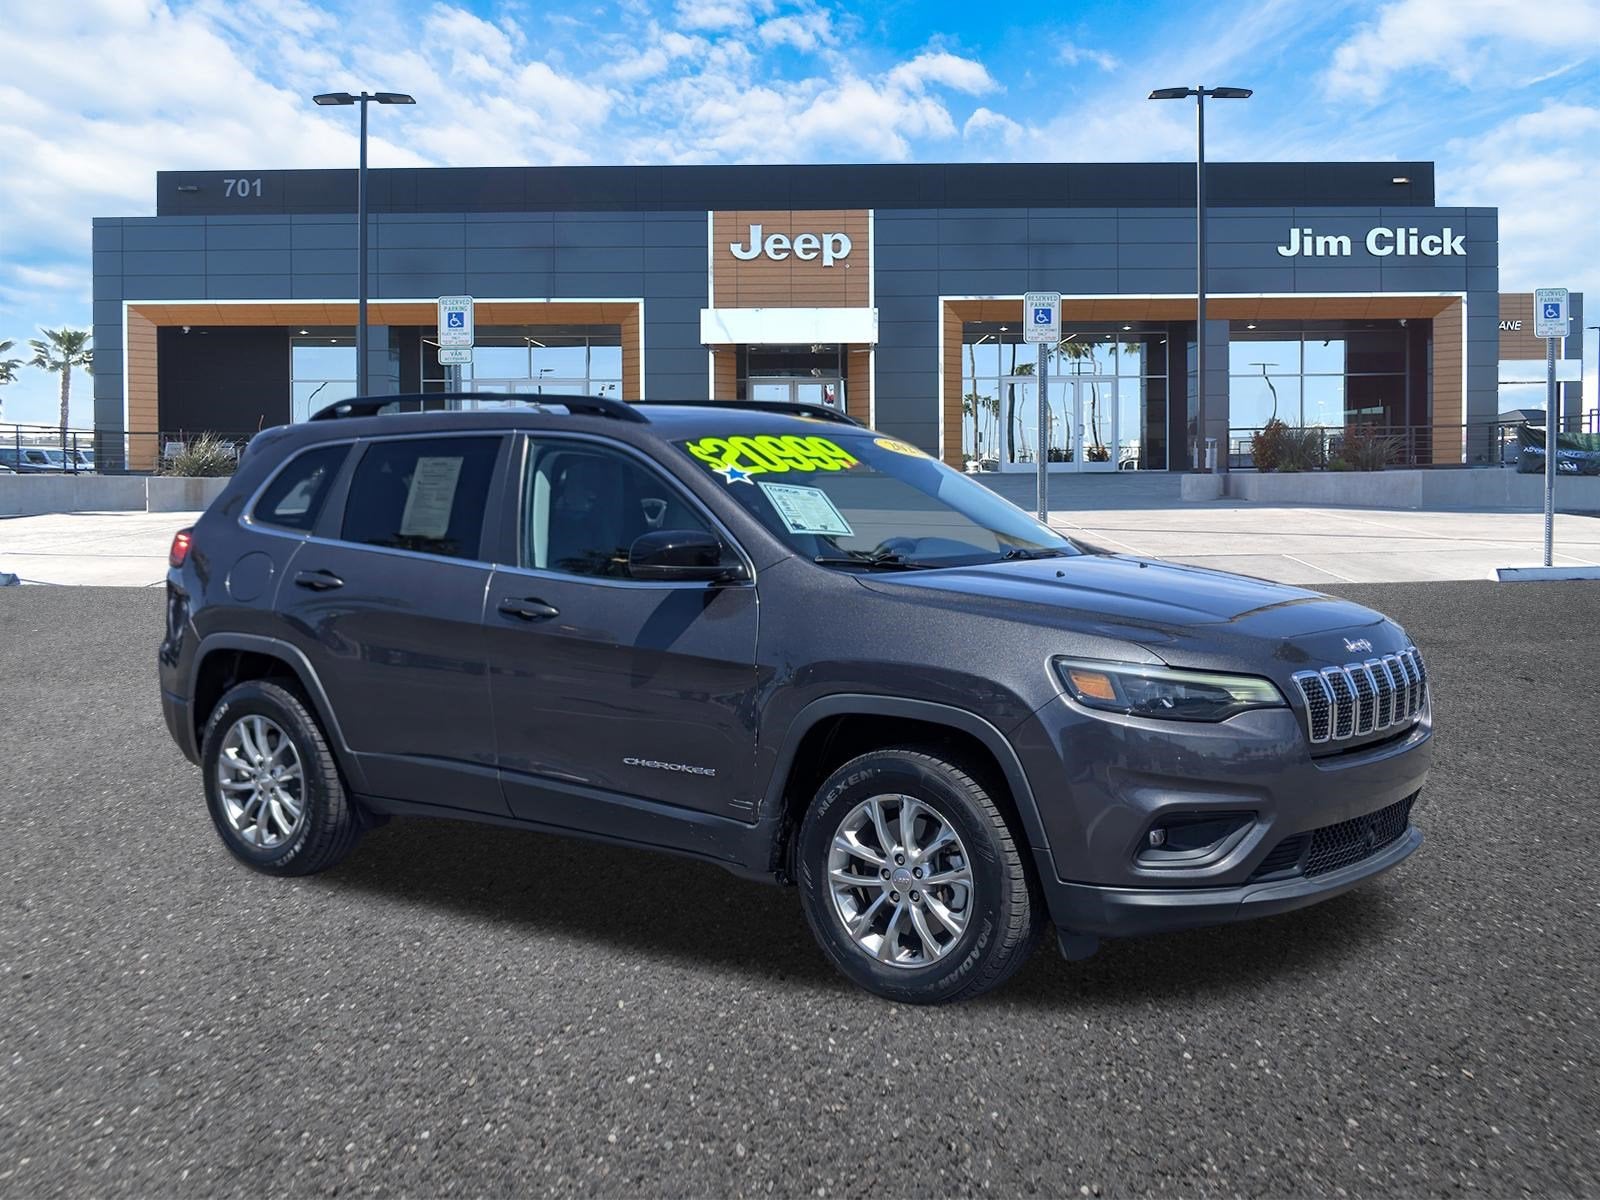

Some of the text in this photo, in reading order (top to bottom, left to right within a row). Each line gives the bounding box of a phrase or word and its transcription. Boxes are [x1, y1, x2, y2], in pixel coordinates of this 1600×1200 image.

[223, 178, 262, 197] 701
[730, 223, 852, 267] Jeep
[1277, 227, 1467, 257] Jim Click
[686, 435, 860, 474] $20999
[1343, 637, 1373, 653] Jeep
[623, 757, 716, 777] CHEROKEE
[818, 768, 874, 818] NEXEN
[937, 917, 993, 990] ROADIAN
